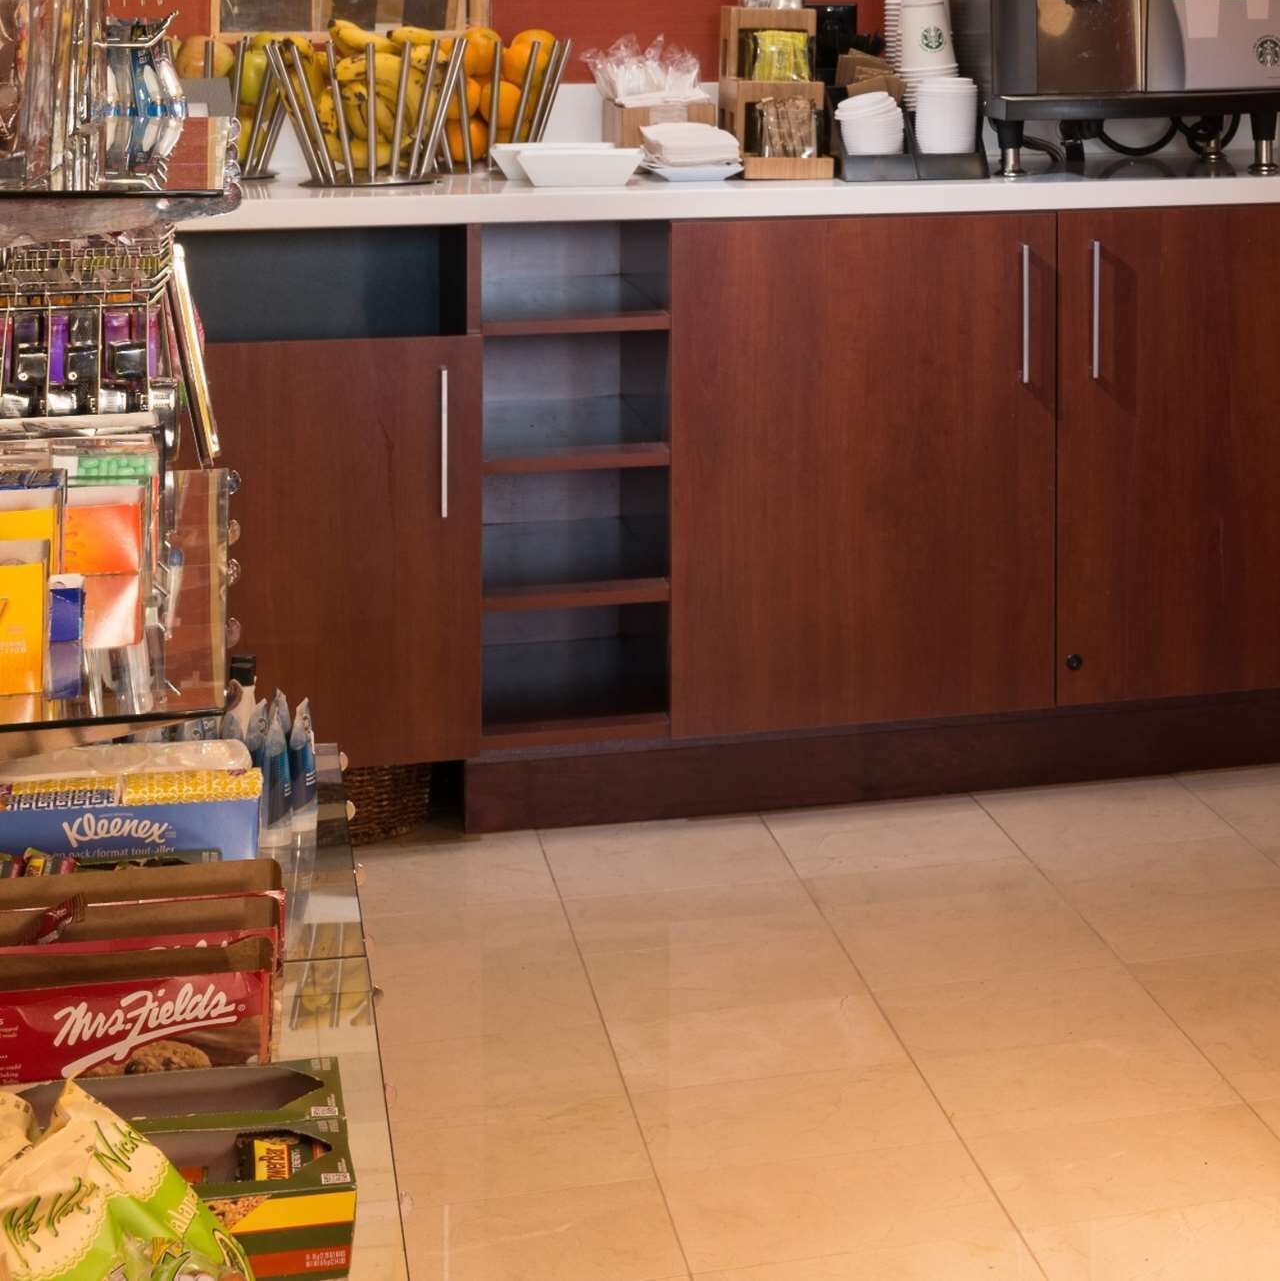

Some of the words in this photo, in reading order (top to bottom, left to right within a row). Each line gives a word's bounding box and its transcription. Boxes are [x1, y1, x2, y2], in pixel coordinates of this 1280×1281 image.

[62, 812, 169, 848] Kleenex
[53, 1001, 132, 1047] Mrs.
[117, 982, 236, 1048] Fields
